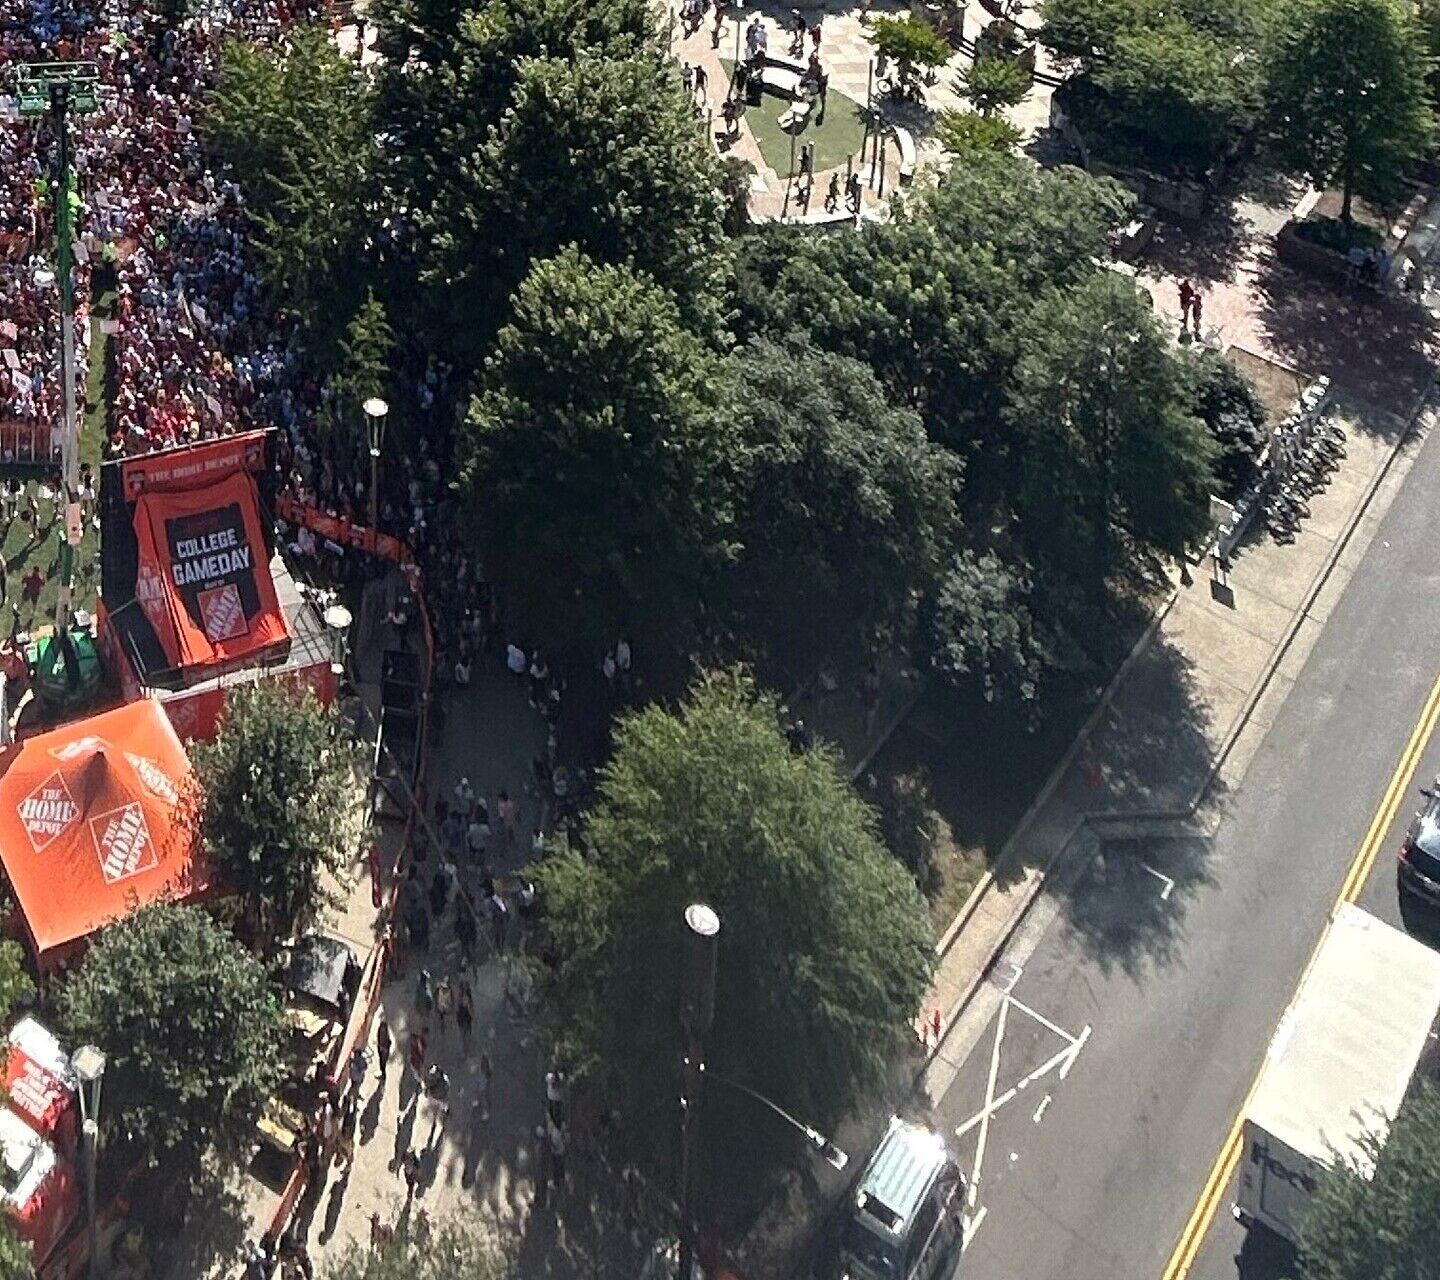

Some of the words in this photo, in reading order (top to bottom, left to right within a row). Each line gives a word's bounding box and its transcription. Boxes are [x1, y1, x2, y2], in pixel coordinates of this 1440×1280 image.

[176, 528, 238, 558] COLLEGE
[172, 546, 250, 586] GAMEDAY
[20, 798, 74, 822] HOME
[29, 820, 63, 835] DEPOT
[104, 806, 144, 878] HOME
[124, 826, 149, 872] DEPOT
